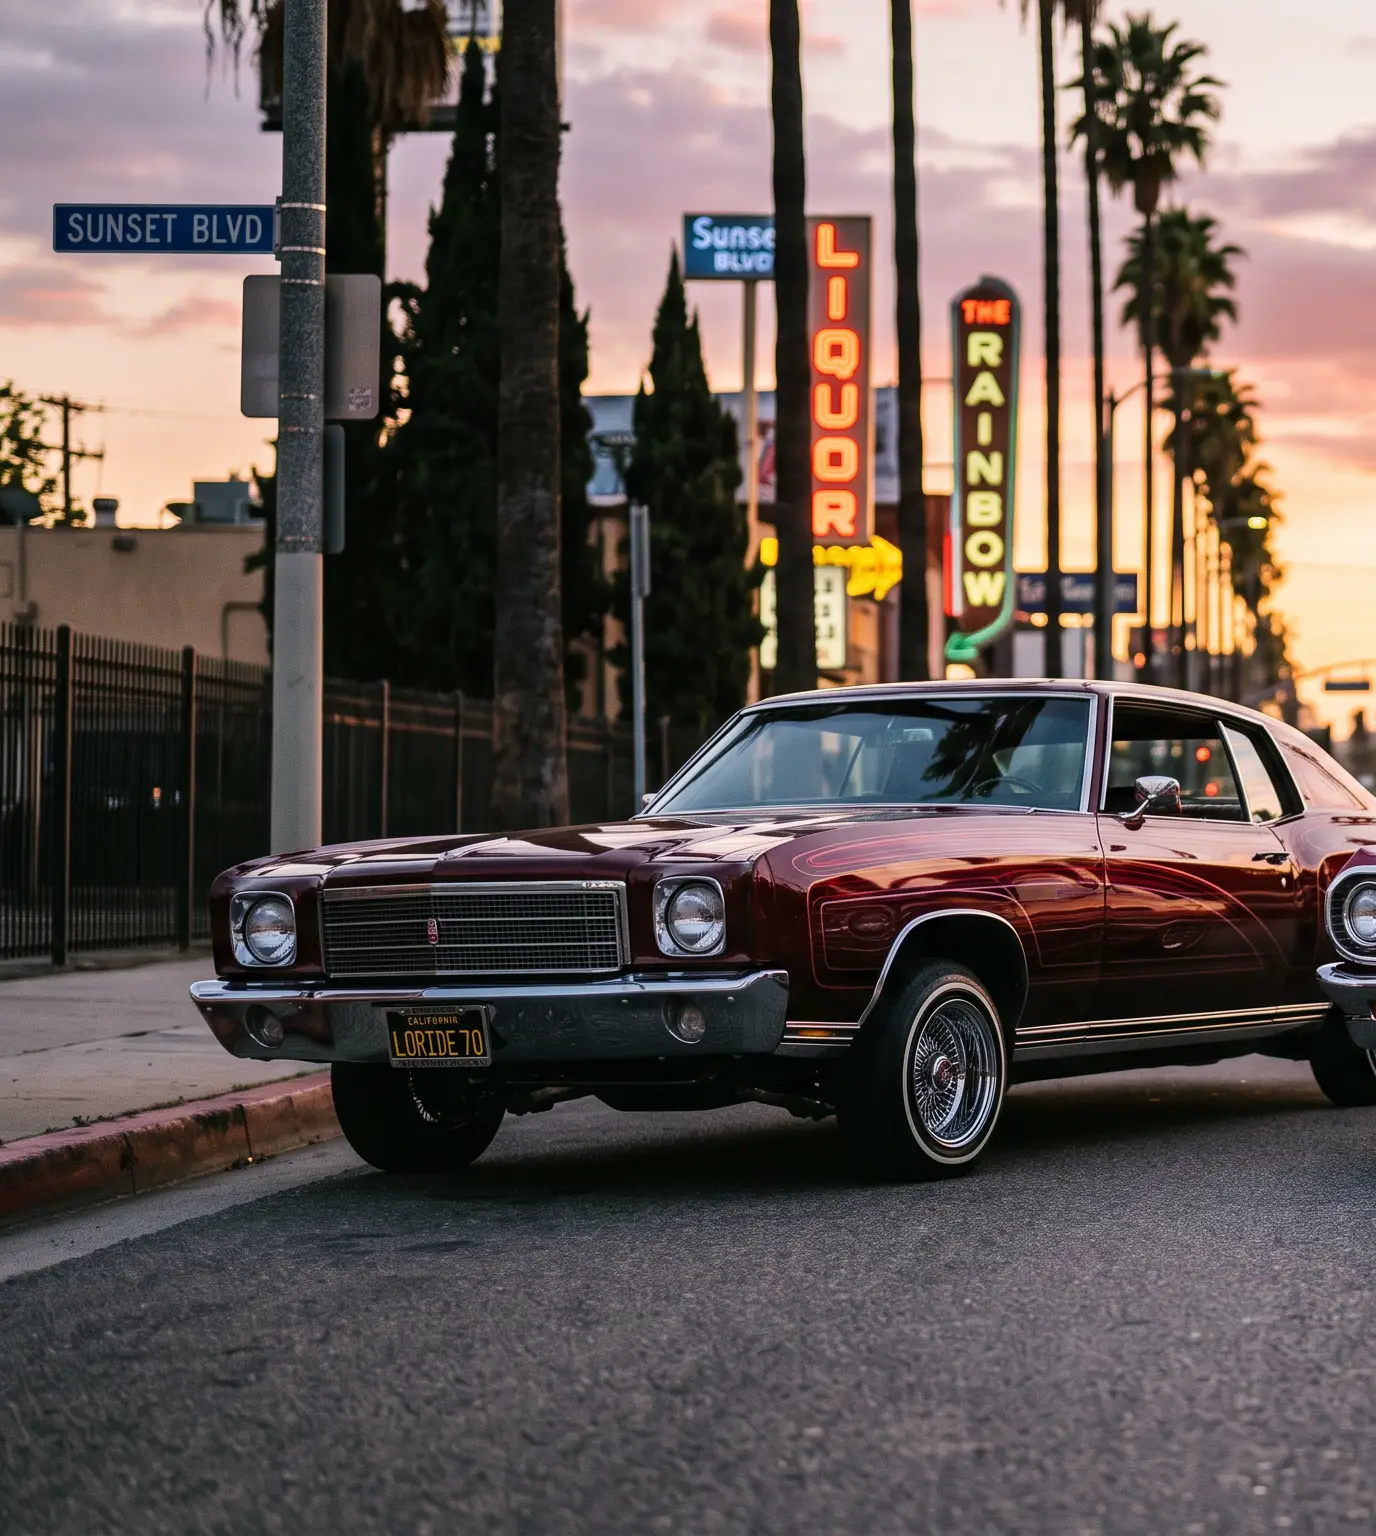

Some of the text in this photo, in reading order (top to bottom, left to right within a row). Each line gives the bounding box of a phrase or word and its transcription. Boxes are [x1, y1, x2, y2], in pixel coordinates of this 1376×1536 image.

[67, 212, 263, 244] SUNSET BLVD
[692, 215, 777, 250] Sunse
[961, 299, 1011, 325] THE
[812, 222, 860, 538] LIQUOR
[963, 331, 1007, 607] RAINBOW
[392, 1029, 484, 1057] LORIDE 70
